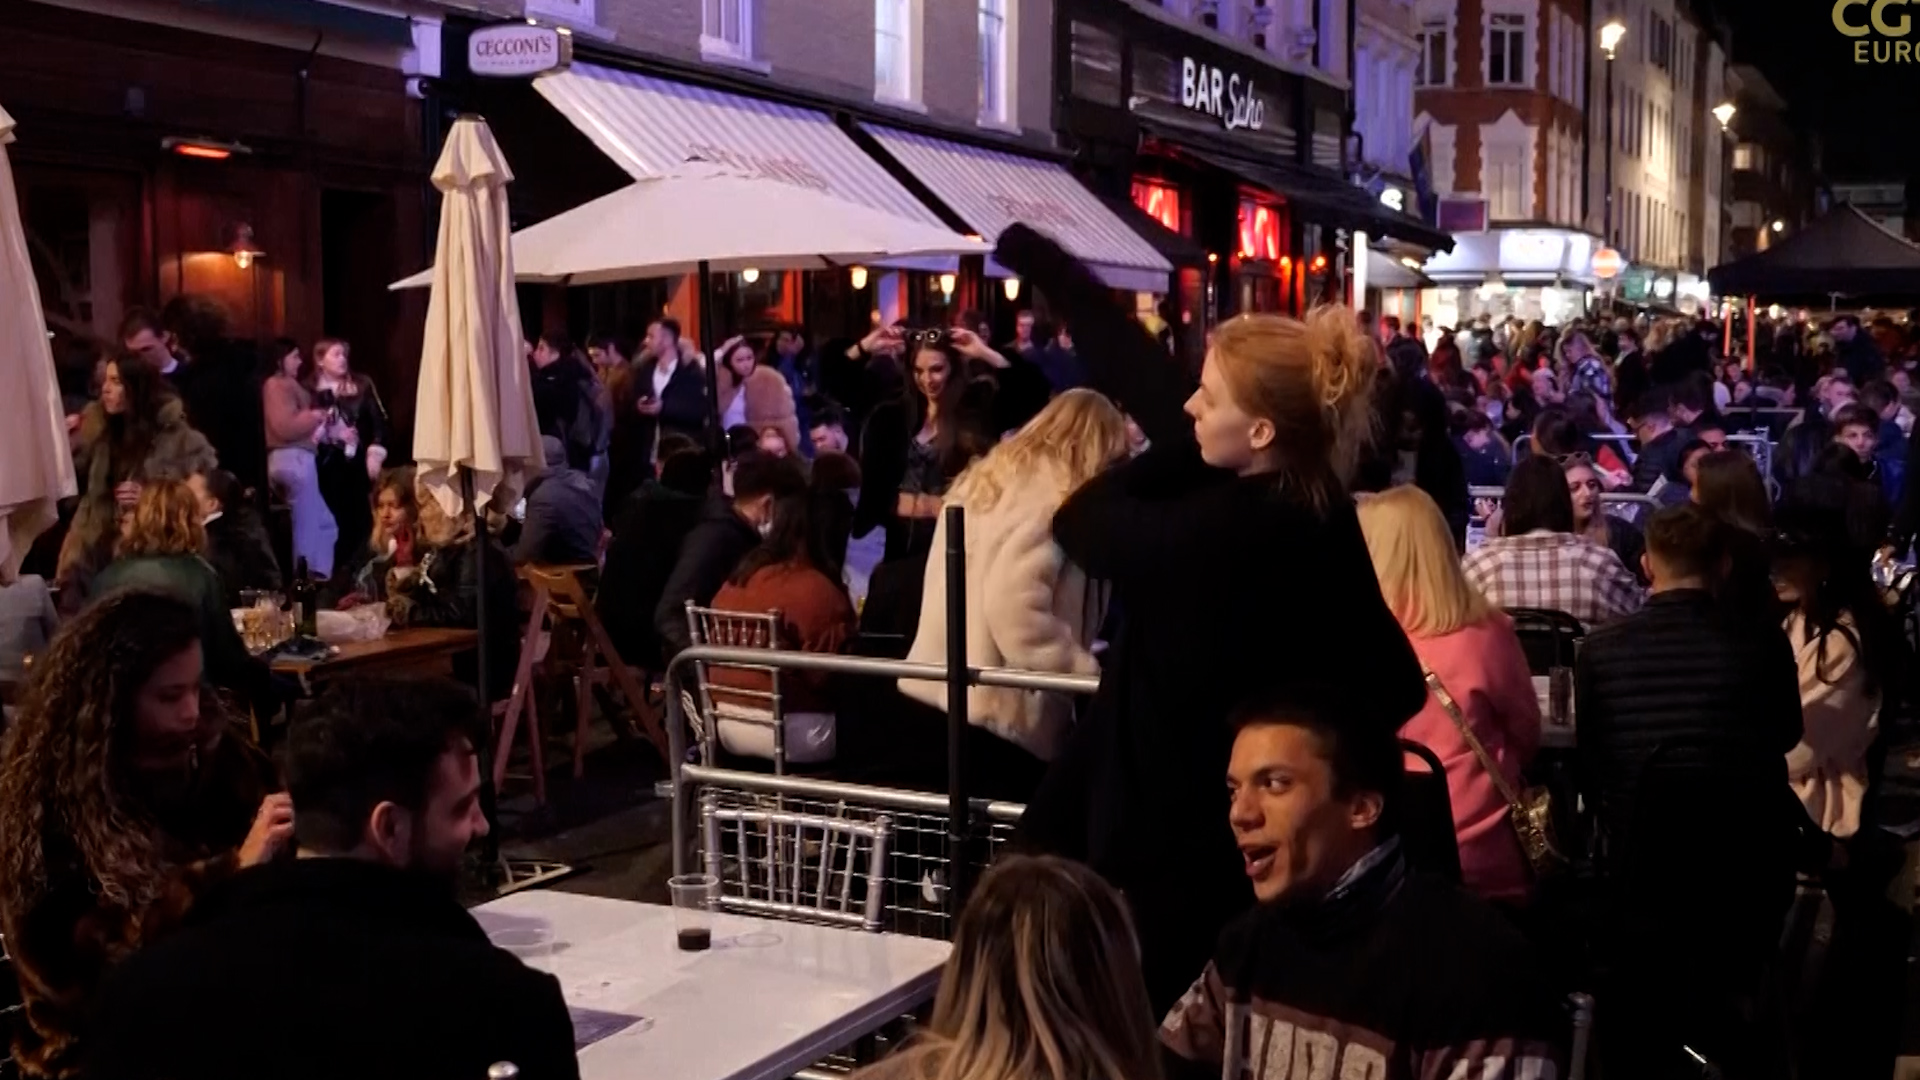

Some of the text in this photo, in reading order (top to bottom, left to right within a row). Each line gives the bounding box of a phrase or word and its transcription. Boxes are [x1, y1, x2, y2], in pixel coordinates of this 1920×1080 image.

[476, 35, 552, 57] CECCONI'S
[1182, 56, 1264, 130] BAR Soho
